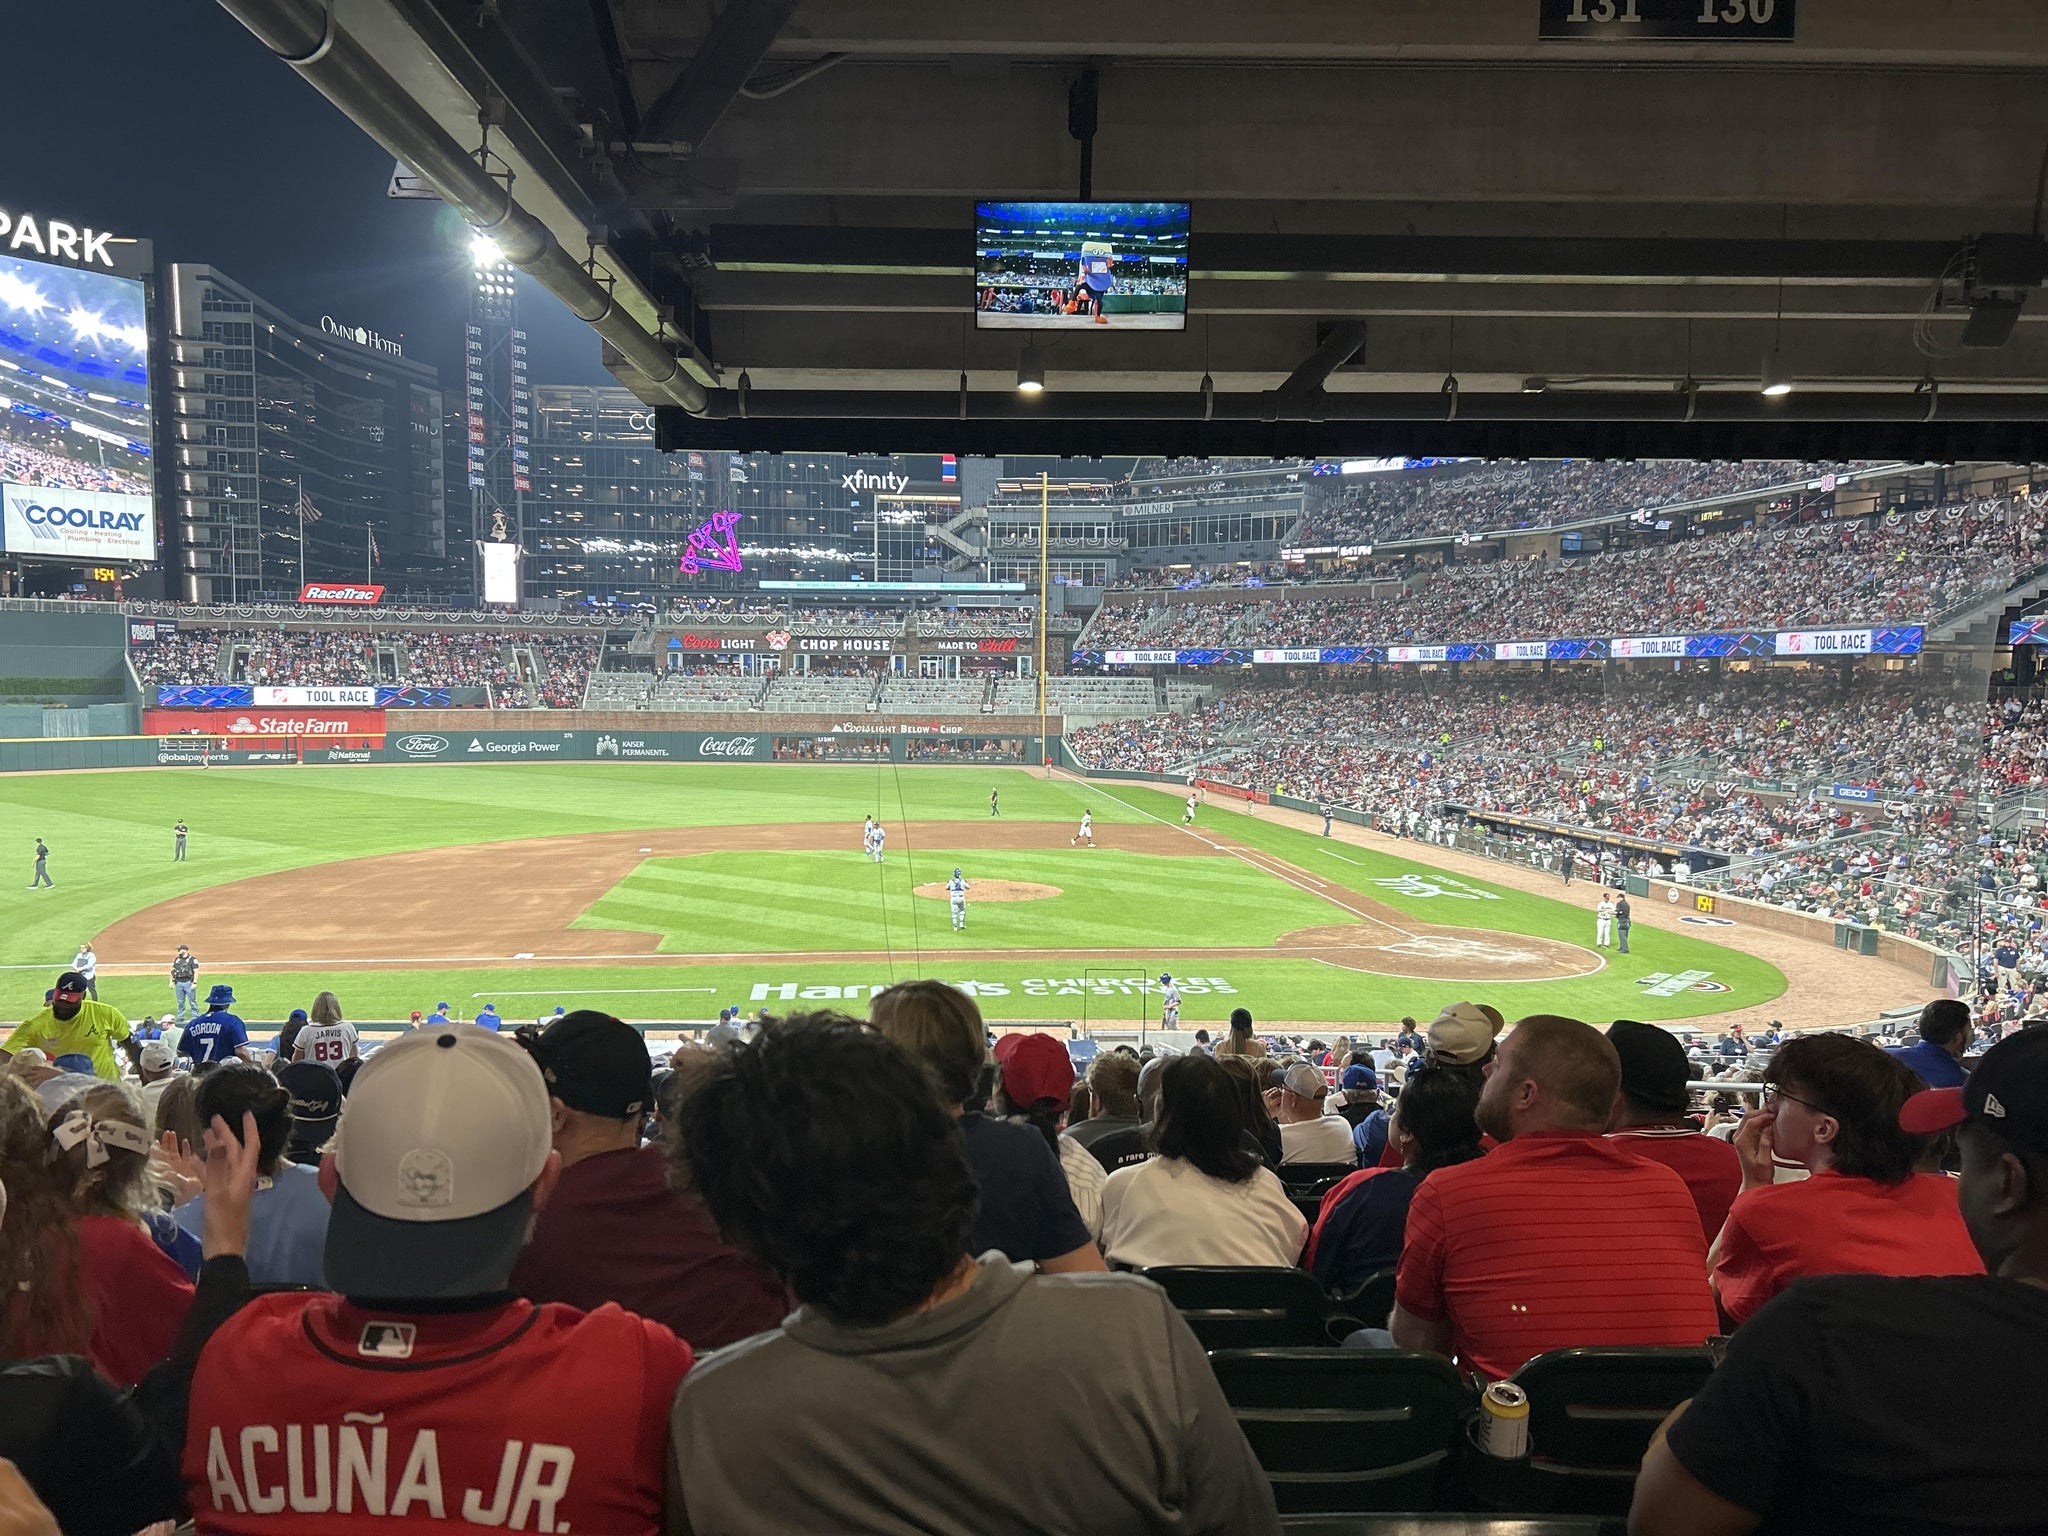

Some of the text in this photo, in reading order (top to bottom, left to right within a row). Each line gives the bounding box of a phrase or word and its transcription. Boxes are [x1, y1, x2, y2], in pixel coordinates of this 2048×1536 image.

[1566, 0, 1774, 23] 131 130
[468, 325, 481, 336] 1872
[513, 329, 526, 340] 1873
[469, 341, 482, 351] 1874
[513, 345, 526, 355] 1875
[469, 356, 481, 365] 1877
[470, 431, 484, 441] 1957
[689, 456, 702, 464] 2021
[731, 456, 743, 464] 2022
[842, 469, 909, 494] xfinity
[1134, 503, 1171, 515] MILNER
[25, 505, 145, 531] COOLRAY
[60, 528, 122, 538] Cooling Heating
[67, 535, 102, 543] Plumbing
[305, 587, 375, 600] RaceTrac
[132, 630, 156, 640] VISION
[683, 634, 756, 649] Coors LIGHT
[800, 639, 890, 650] CHOP HOUSE
[938, 637, 1017, 652] MADE TO Chill
[1641, 641, 1681, 653] TOOL RACE
[1814, 634, 1866, 649] TOOL RACE
[1284, 651, 1317, 660] TOOL RACE
[1418, 649, 1444, 658] TOOL RACE
[1516, 645, 1544, 656] TOOL RACE
[1134, 653, 1172, 661] TOOL RACE
[306, 691, 369, 701] TOOL RACE
[842, 721, 870, 733] Coors
[870, 725, 896, 733] LIGHT
[900, 725, 930, 734] BELOW
[940, 725, 963, 734] CHOP
[406, 737, 439, 751] Ford
[486, 742, 560, 754] Georgia Power
[700, 736, 758, 756] Coca-Cola
[338, 751, 370, 760] National
[1840, 788, 1867, 798] GEICO
[190, 1023, 221, 1037] GORDON
[315, 1029, 342, 1039] JARVIS
[200, 1038, 214, 1063] 7
[315, 1041, 343, 1061] 83
[1126, 1152, 1145, 1162] rare
[206, 1411, 576, 1534] ACUÑA JR.
